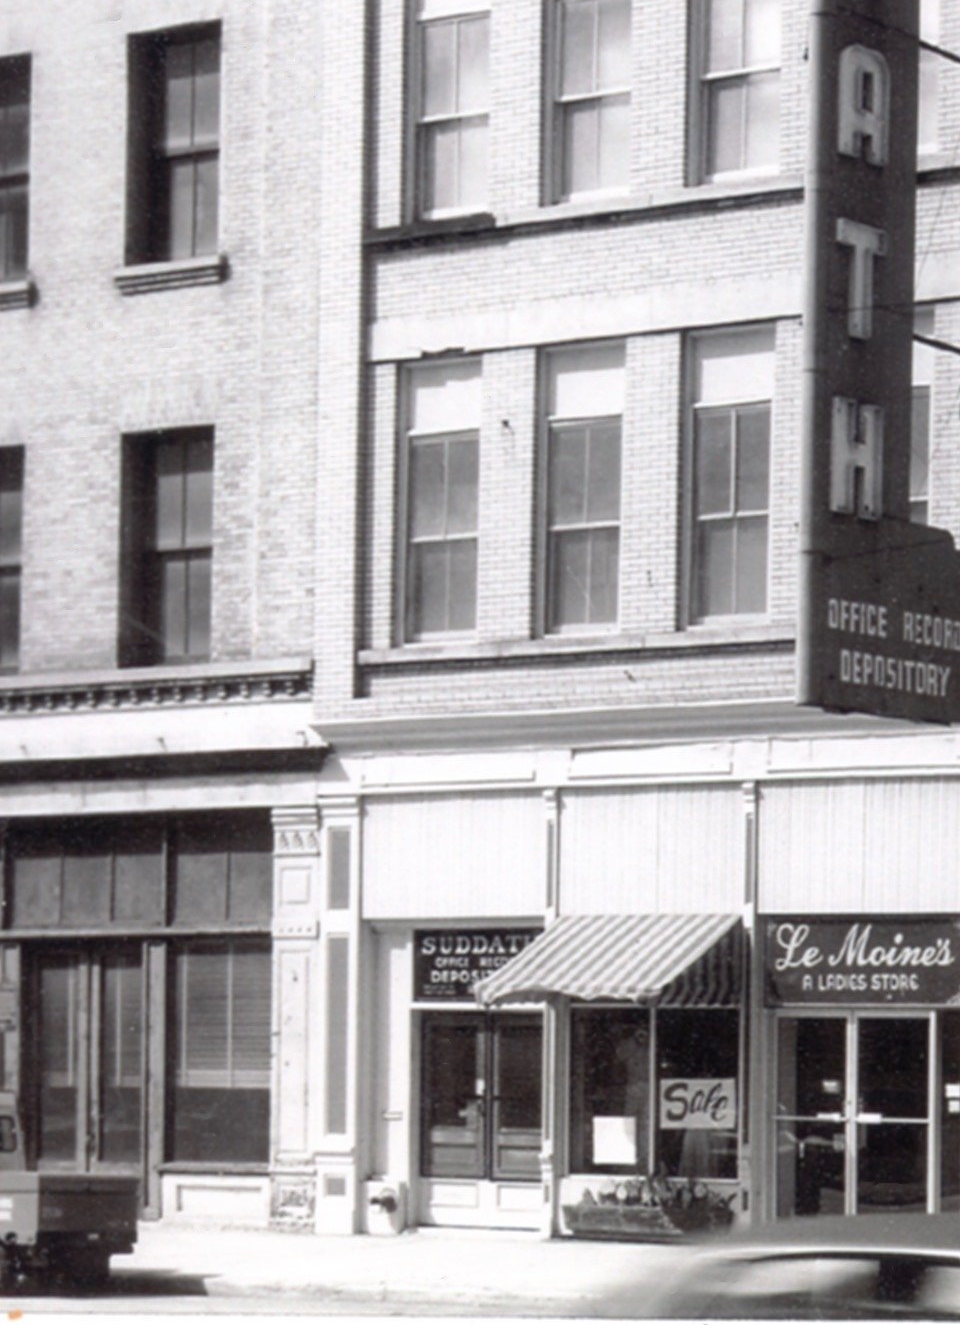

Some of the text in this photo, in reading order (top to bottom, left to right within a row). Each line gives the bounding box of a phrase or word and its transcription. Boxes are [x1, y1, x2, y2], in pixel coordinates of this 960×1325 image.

[828, 598, 889, 638] OFFICE
[840, 648, 951, 697] DEPOSITORY
[434, 956, 509, 969] OFFICE RECO
[775, 923, 955, 971] Le Moine's
[802, 973, 920, 992] A LADIES STORE
[663, 1082, 729, 1122] Sale
